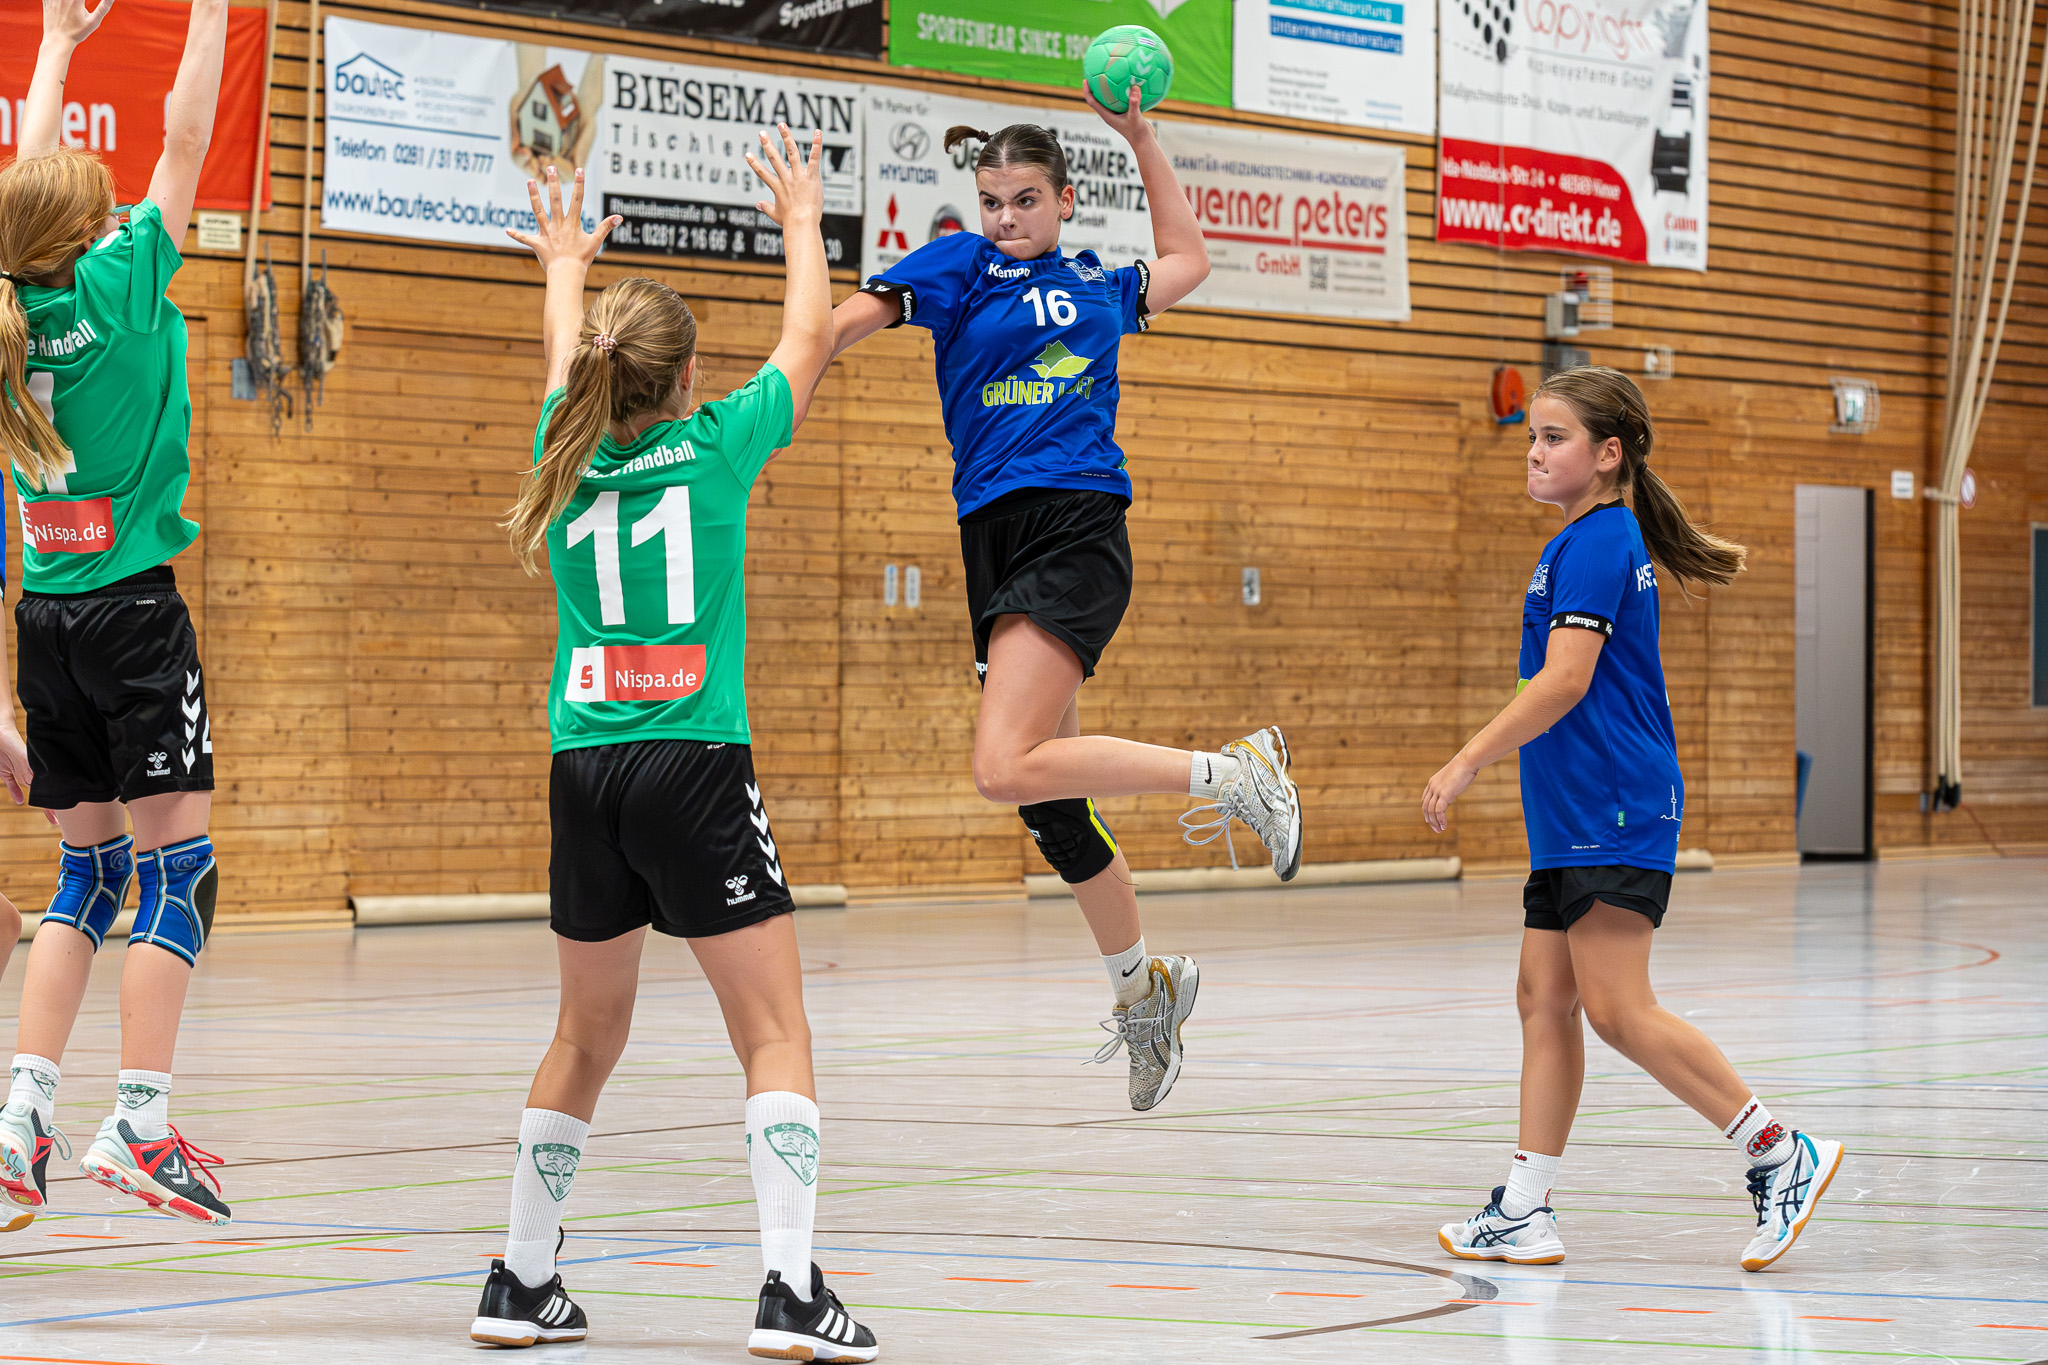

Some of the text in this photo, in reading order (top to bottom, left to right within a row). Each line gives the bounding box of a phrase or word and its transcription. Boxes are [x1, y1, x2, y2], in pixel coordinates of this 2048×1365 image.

[917, 12, 1015, 53] SPORTSWEAR
[1019, 27, 1062, 58] SINCE
[1272, 17, 1402, 52] Unternehmensberatung
[613, 71, 855, 134] BIESEMANN
[334, 136, 386, 161] Telefon
[471, 153, 494, 175] 777
[1064, 147, 1136, 179] RAMER-
[880, 163, 939, 186] HYUNDAI
[1068, 179, 1147, 212] CHMITZ
[1293, 189, 1388, 247] peters
[1441, 197, 1622, 249] www.cr-direkt.de
[677, 226, 689, 249] 2
[732, 230, 746, 254] &
[1256, 251, 1301, 278] GmbH
[902, 291, 913, 322] Kempa
[1022, 287, 1078, 327] 16
[38, 318, 97, 357] Hndall
[982, 375, 1055, 407] GRÜNER
[622, 440, 696, 475] Handball
[34, 521, 107, 545] Nispa.de
[567, 485, 695, 626] 11
[1565, 614, 1600, 628] Kempa
[615, 667, 697, 692] Nispa.de
[147, 767, 171, 777] hummel
[726, 890, 757, 907] hummel
